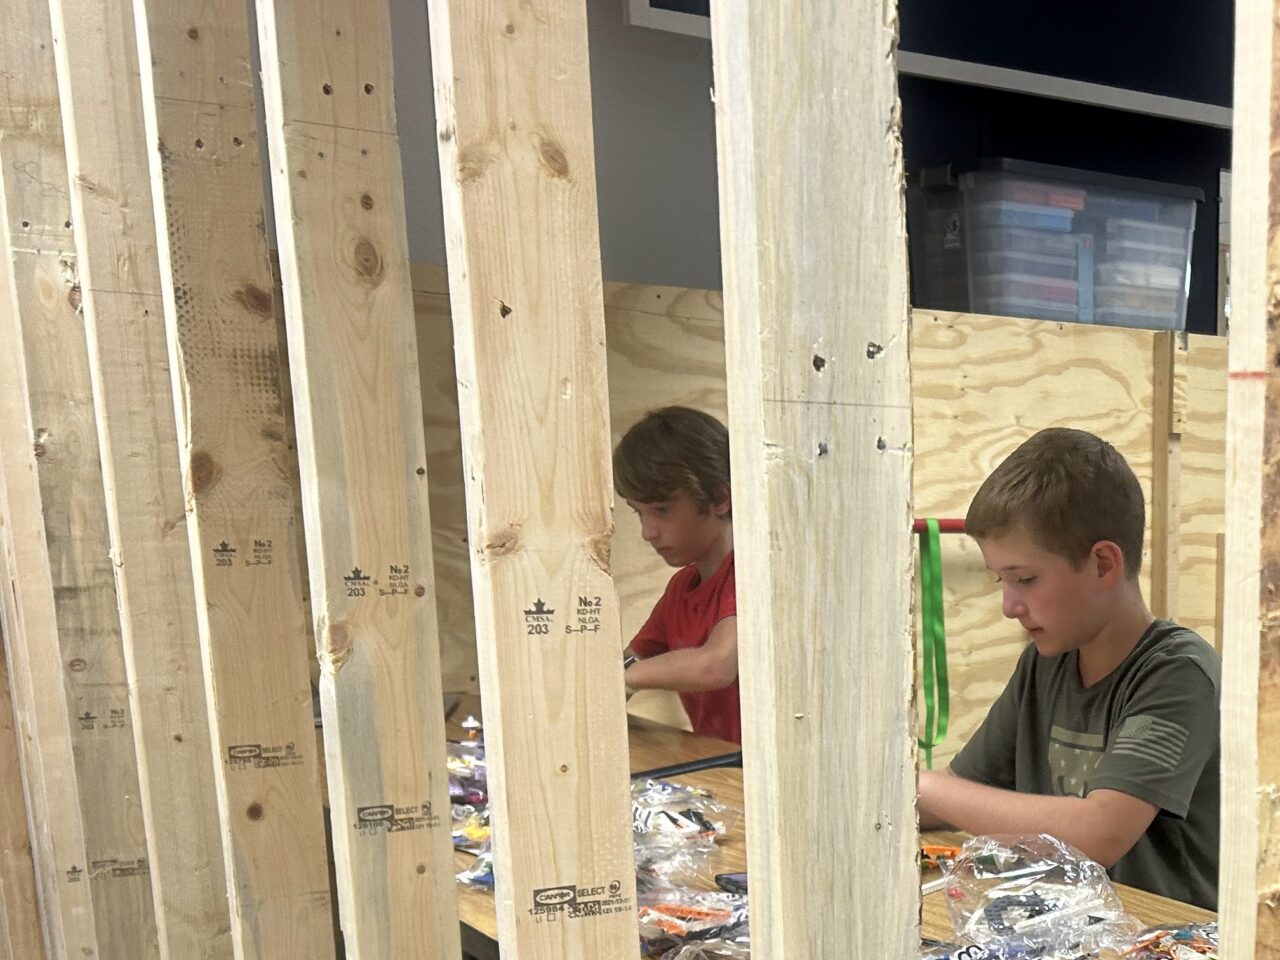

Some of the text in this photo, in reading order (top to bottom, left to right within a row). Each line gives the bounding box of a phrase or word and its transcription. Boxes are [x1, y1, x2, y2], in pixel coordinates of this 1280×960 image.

[216, 559, 233, 567] 203
[347, 588, 366, 597] 203
[527, 624, 549, 635] 203
[395, 806, 419, 815] SELECT
[577, 886, 606, 898] SELECT
